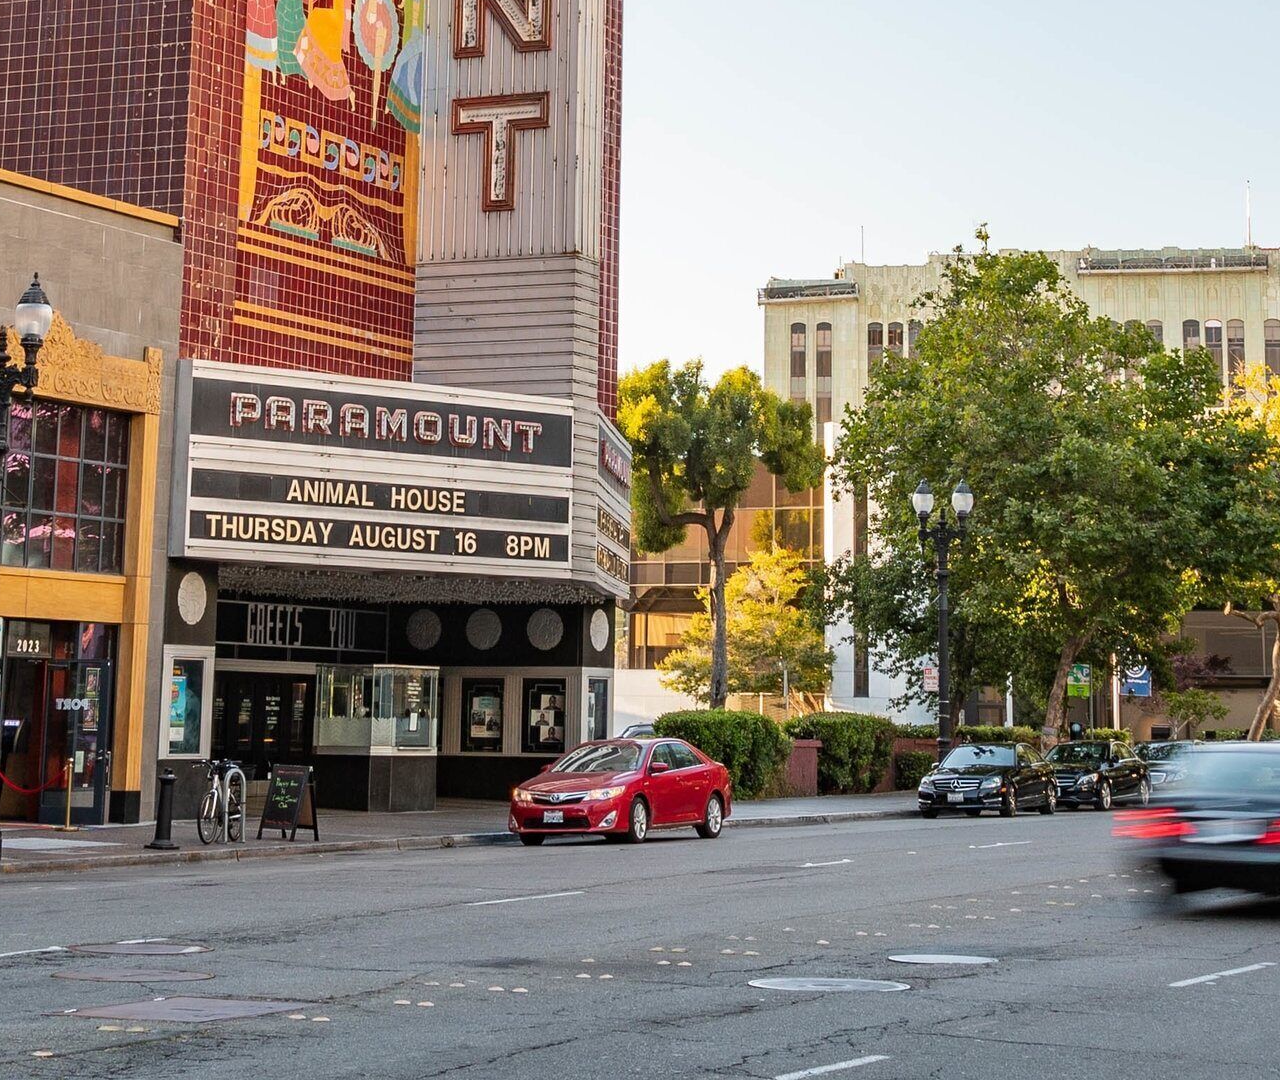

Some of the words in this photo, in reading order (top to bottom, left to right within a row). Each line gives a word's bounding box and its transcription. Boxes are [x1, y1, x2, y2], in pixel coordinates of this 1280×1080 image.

[230, 392, 542, 453] PARAMOUNT
[287, 479, 374, 508] ANIMAL
[391, 487, 466, 514] HOUSE
[206, 514, 334, 546] THURSDAY
[349, 525, 440, 552] AUGUST
[455, 531, 477, 554] 16
[506, 534, 551, 559] 8PM
[17, 639, 40, 653] 2023
